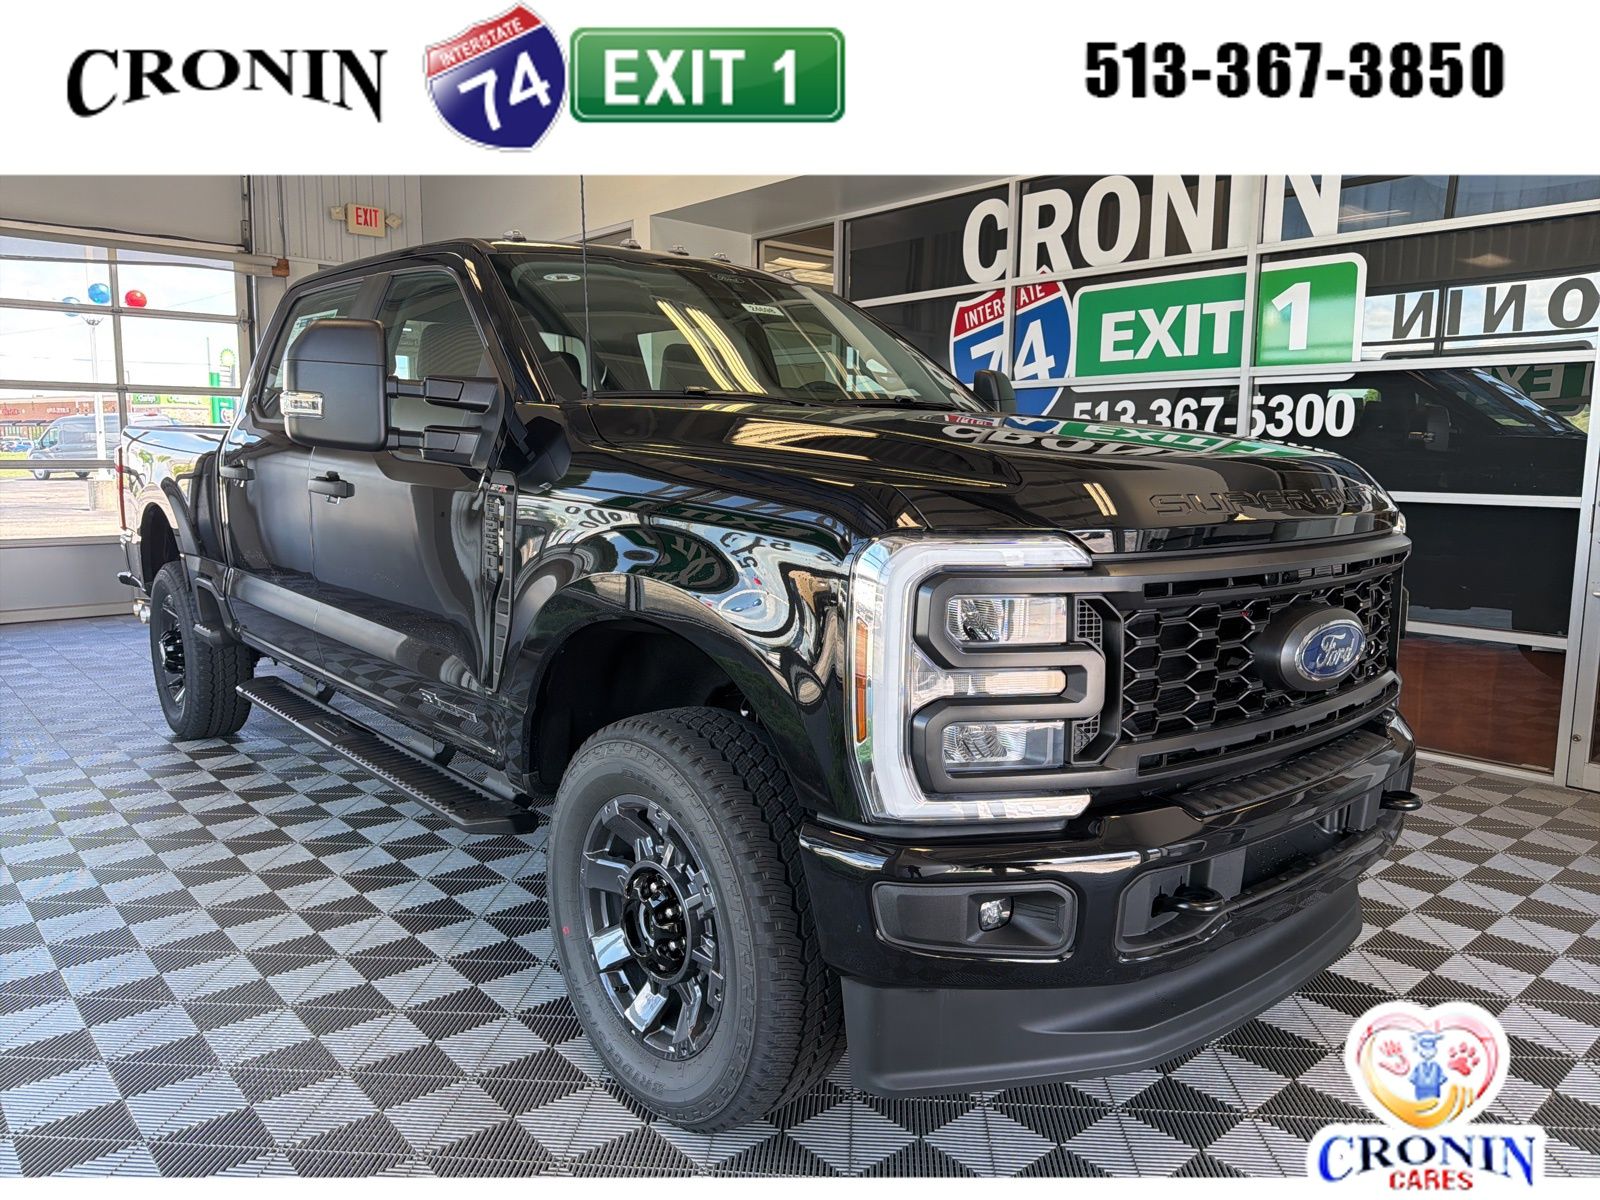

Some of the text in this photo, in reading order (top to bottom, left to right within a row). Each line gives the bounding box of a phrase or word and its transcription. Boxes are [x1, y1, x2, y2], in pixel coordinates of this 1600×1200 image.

[354, 205, 380, 229] EXIT
[962, 174, 1341, 284] CRONIN
[964, 284, 1047, 330] INTERATE
[1099, 281, 1311, 363] EXIT 1
[970, 319, 1056, 381] 74
[1149, 488, 1316, 518] SUPER
[1315, 632, 1356, 668] Ford
